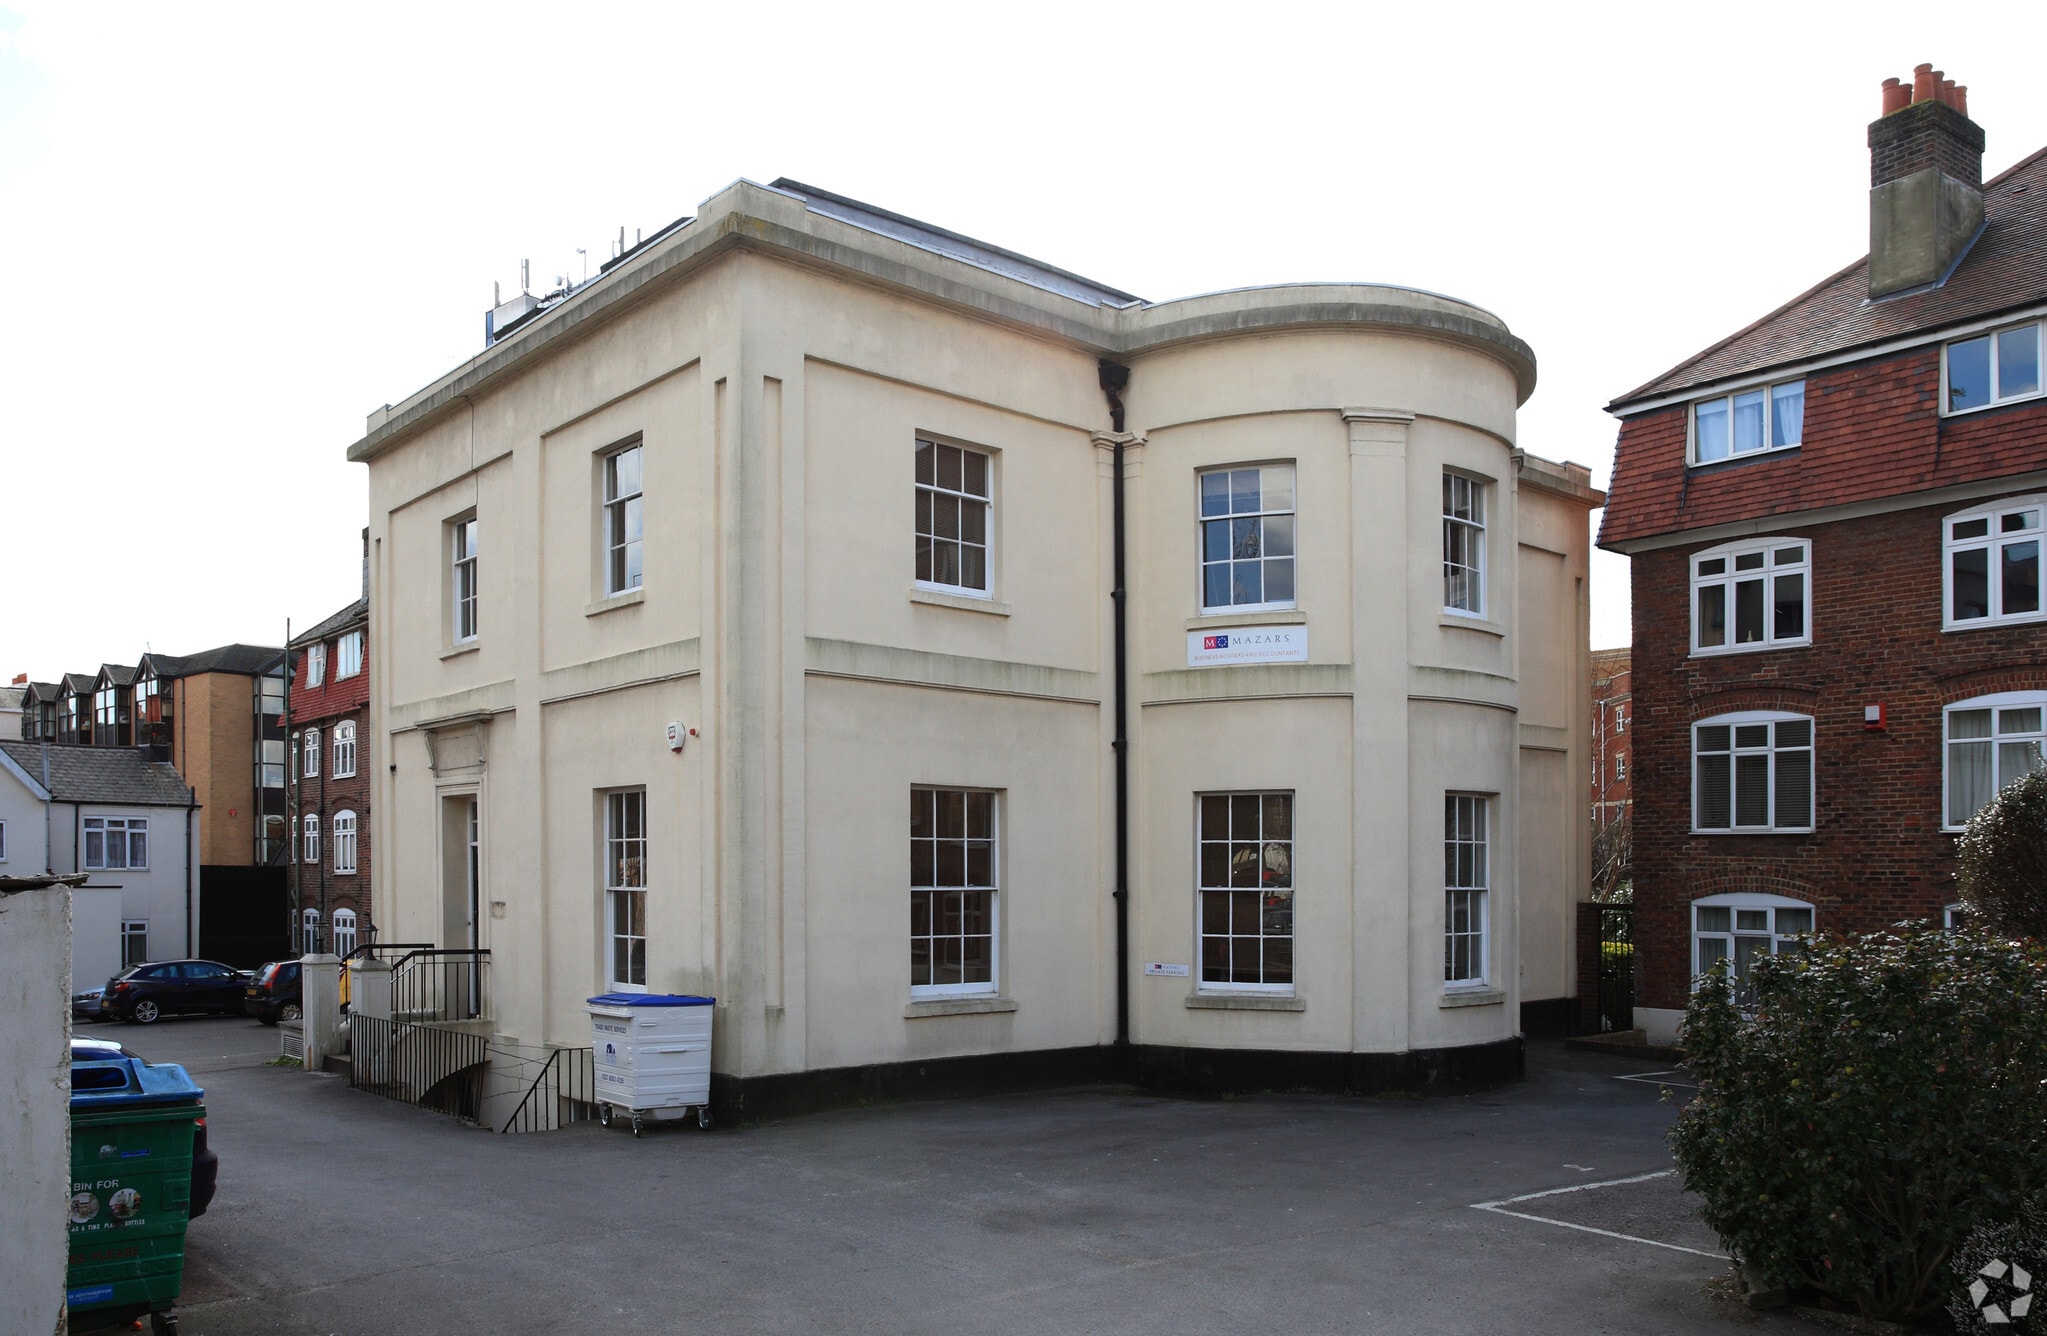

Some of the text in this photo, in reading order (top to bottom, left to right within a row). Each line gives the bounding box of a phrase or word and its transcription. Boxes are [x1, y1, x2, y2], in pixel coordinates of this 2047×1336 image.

[1232, 634, 1290, 645] MAZARS
[73, 1179, 119, 1191] BIN FOR
[91, 1245, 140, 1262] PLEASE
